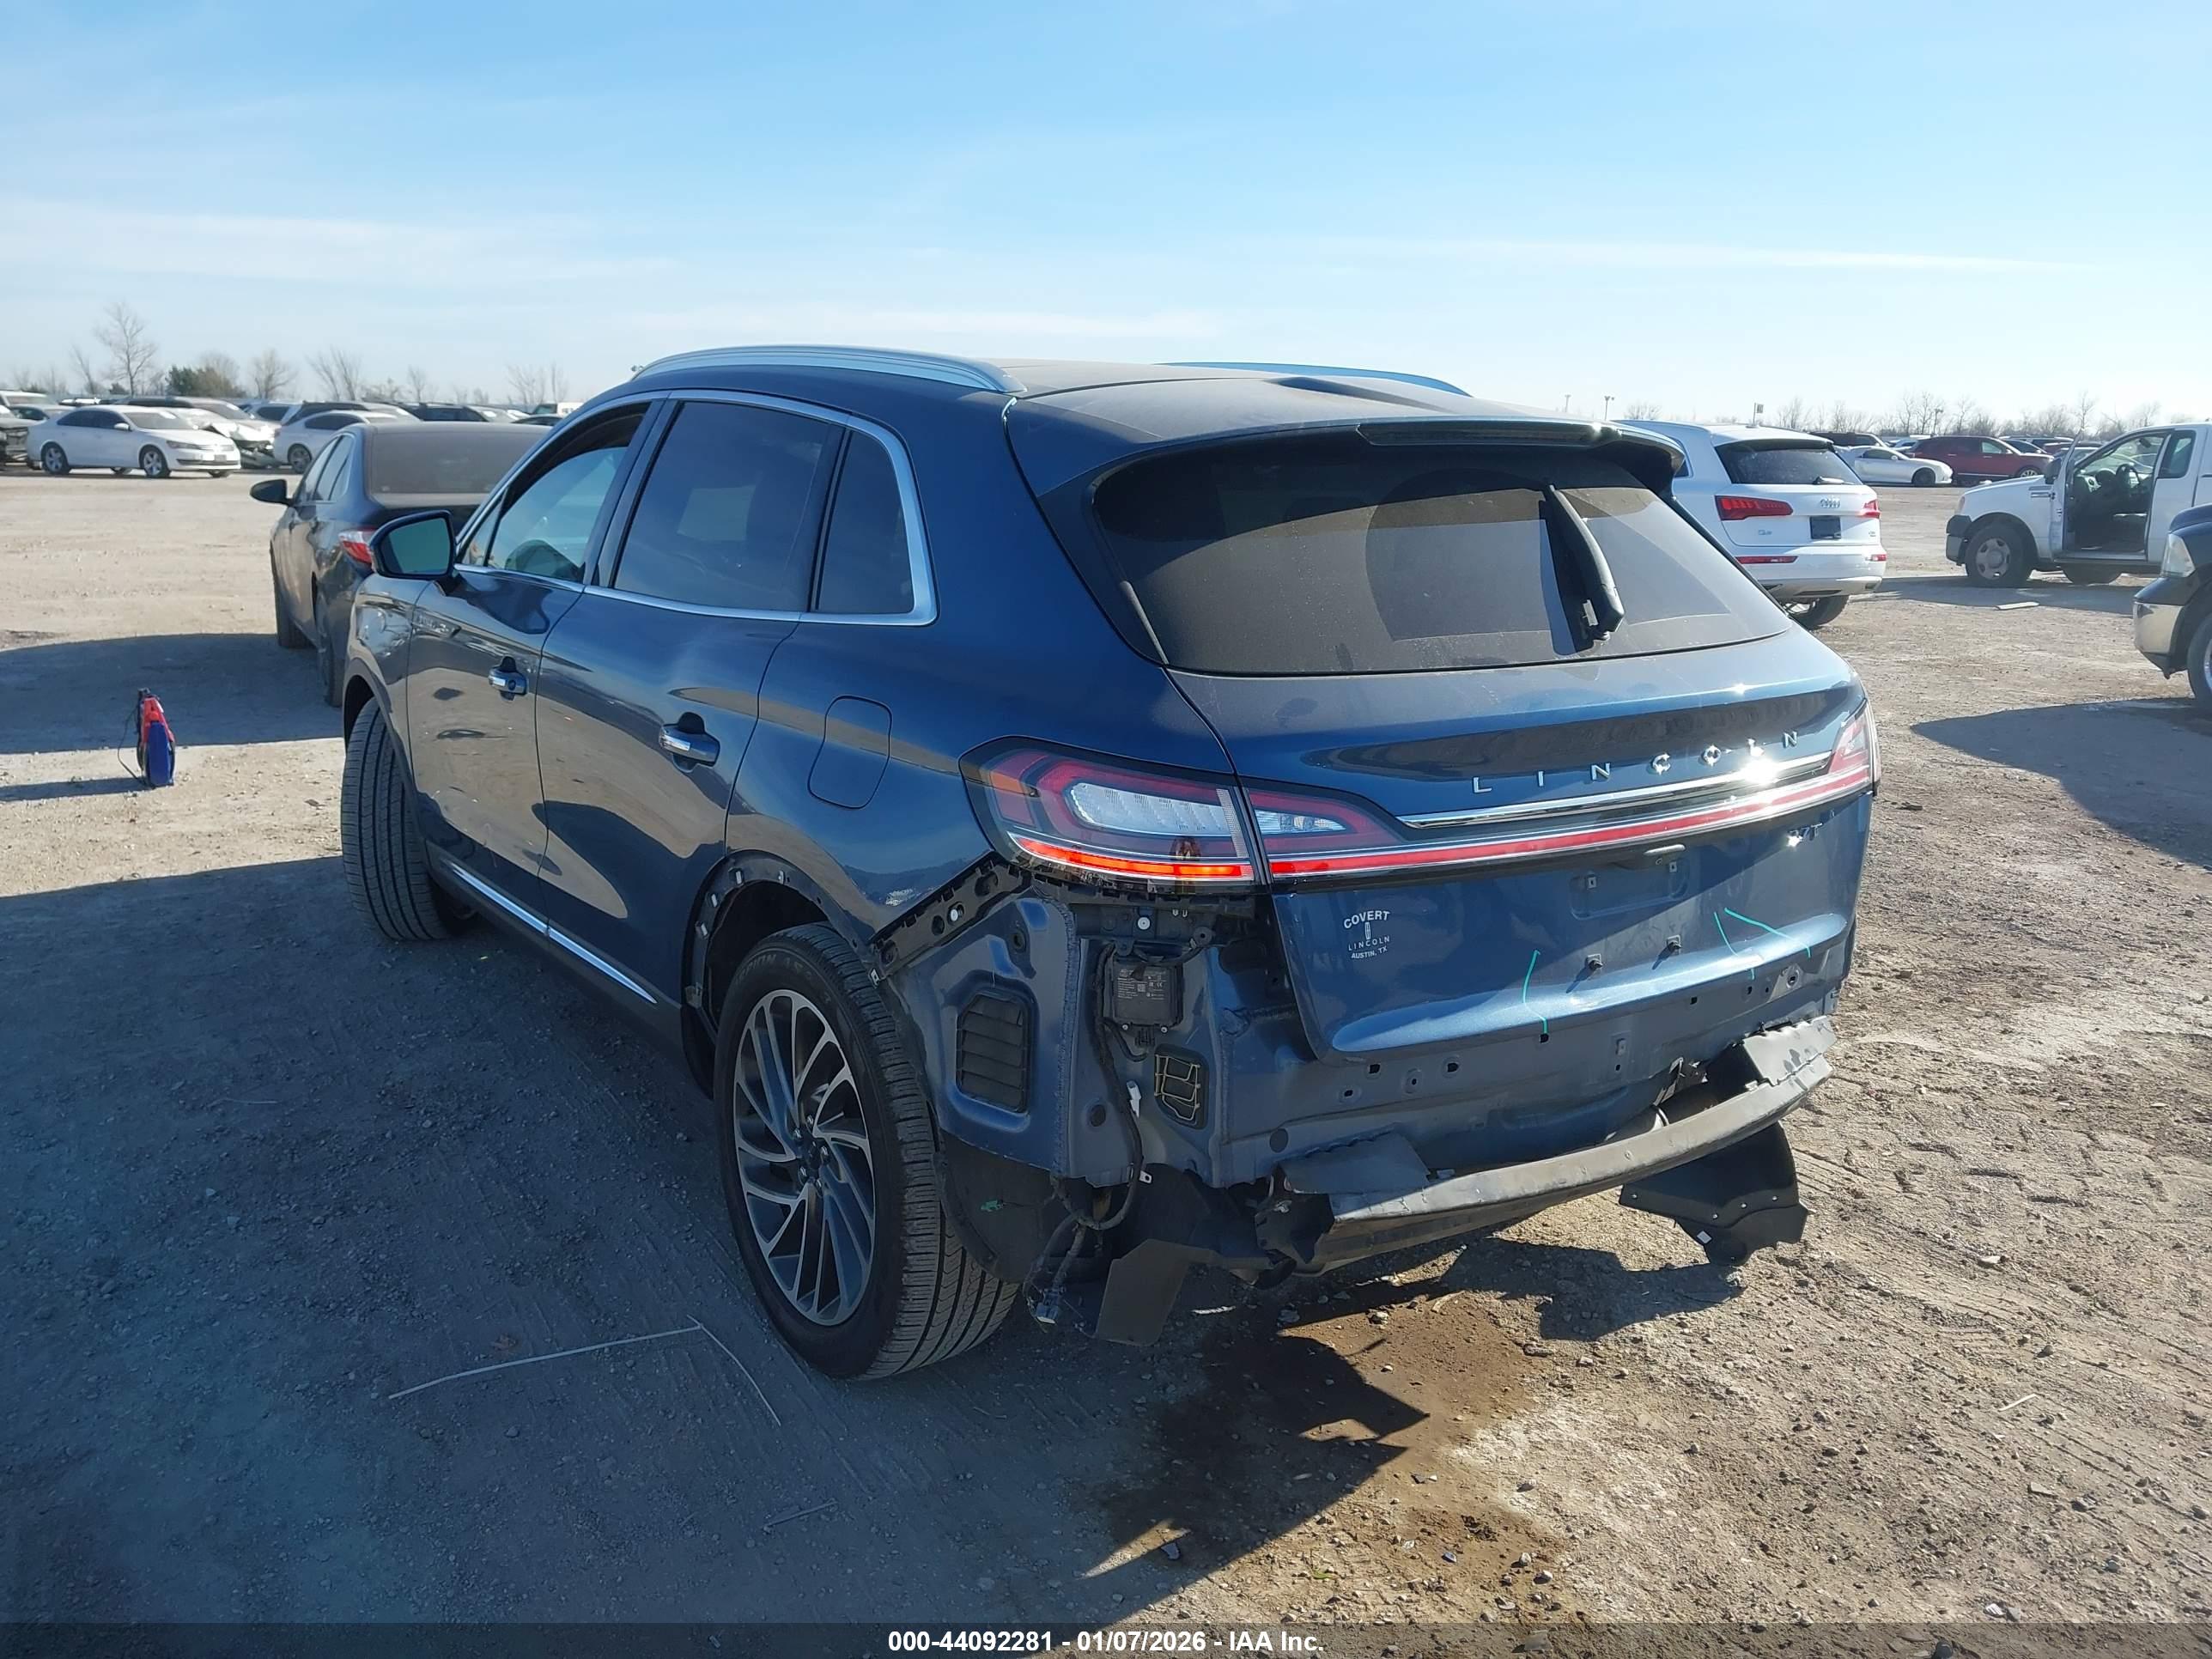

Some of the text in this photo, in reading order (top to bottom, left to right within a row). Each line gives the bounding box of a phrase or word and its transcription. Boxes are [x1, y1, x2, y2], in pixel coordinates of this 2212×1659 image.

[1472, 730, 1798, 794] LINCOLN
[1343, 910, 1391, 929] COVERT
[1347, 935, 1390, 952] LINCOLN
[1351, 945, 1388, 959] AUSTIN, TX
